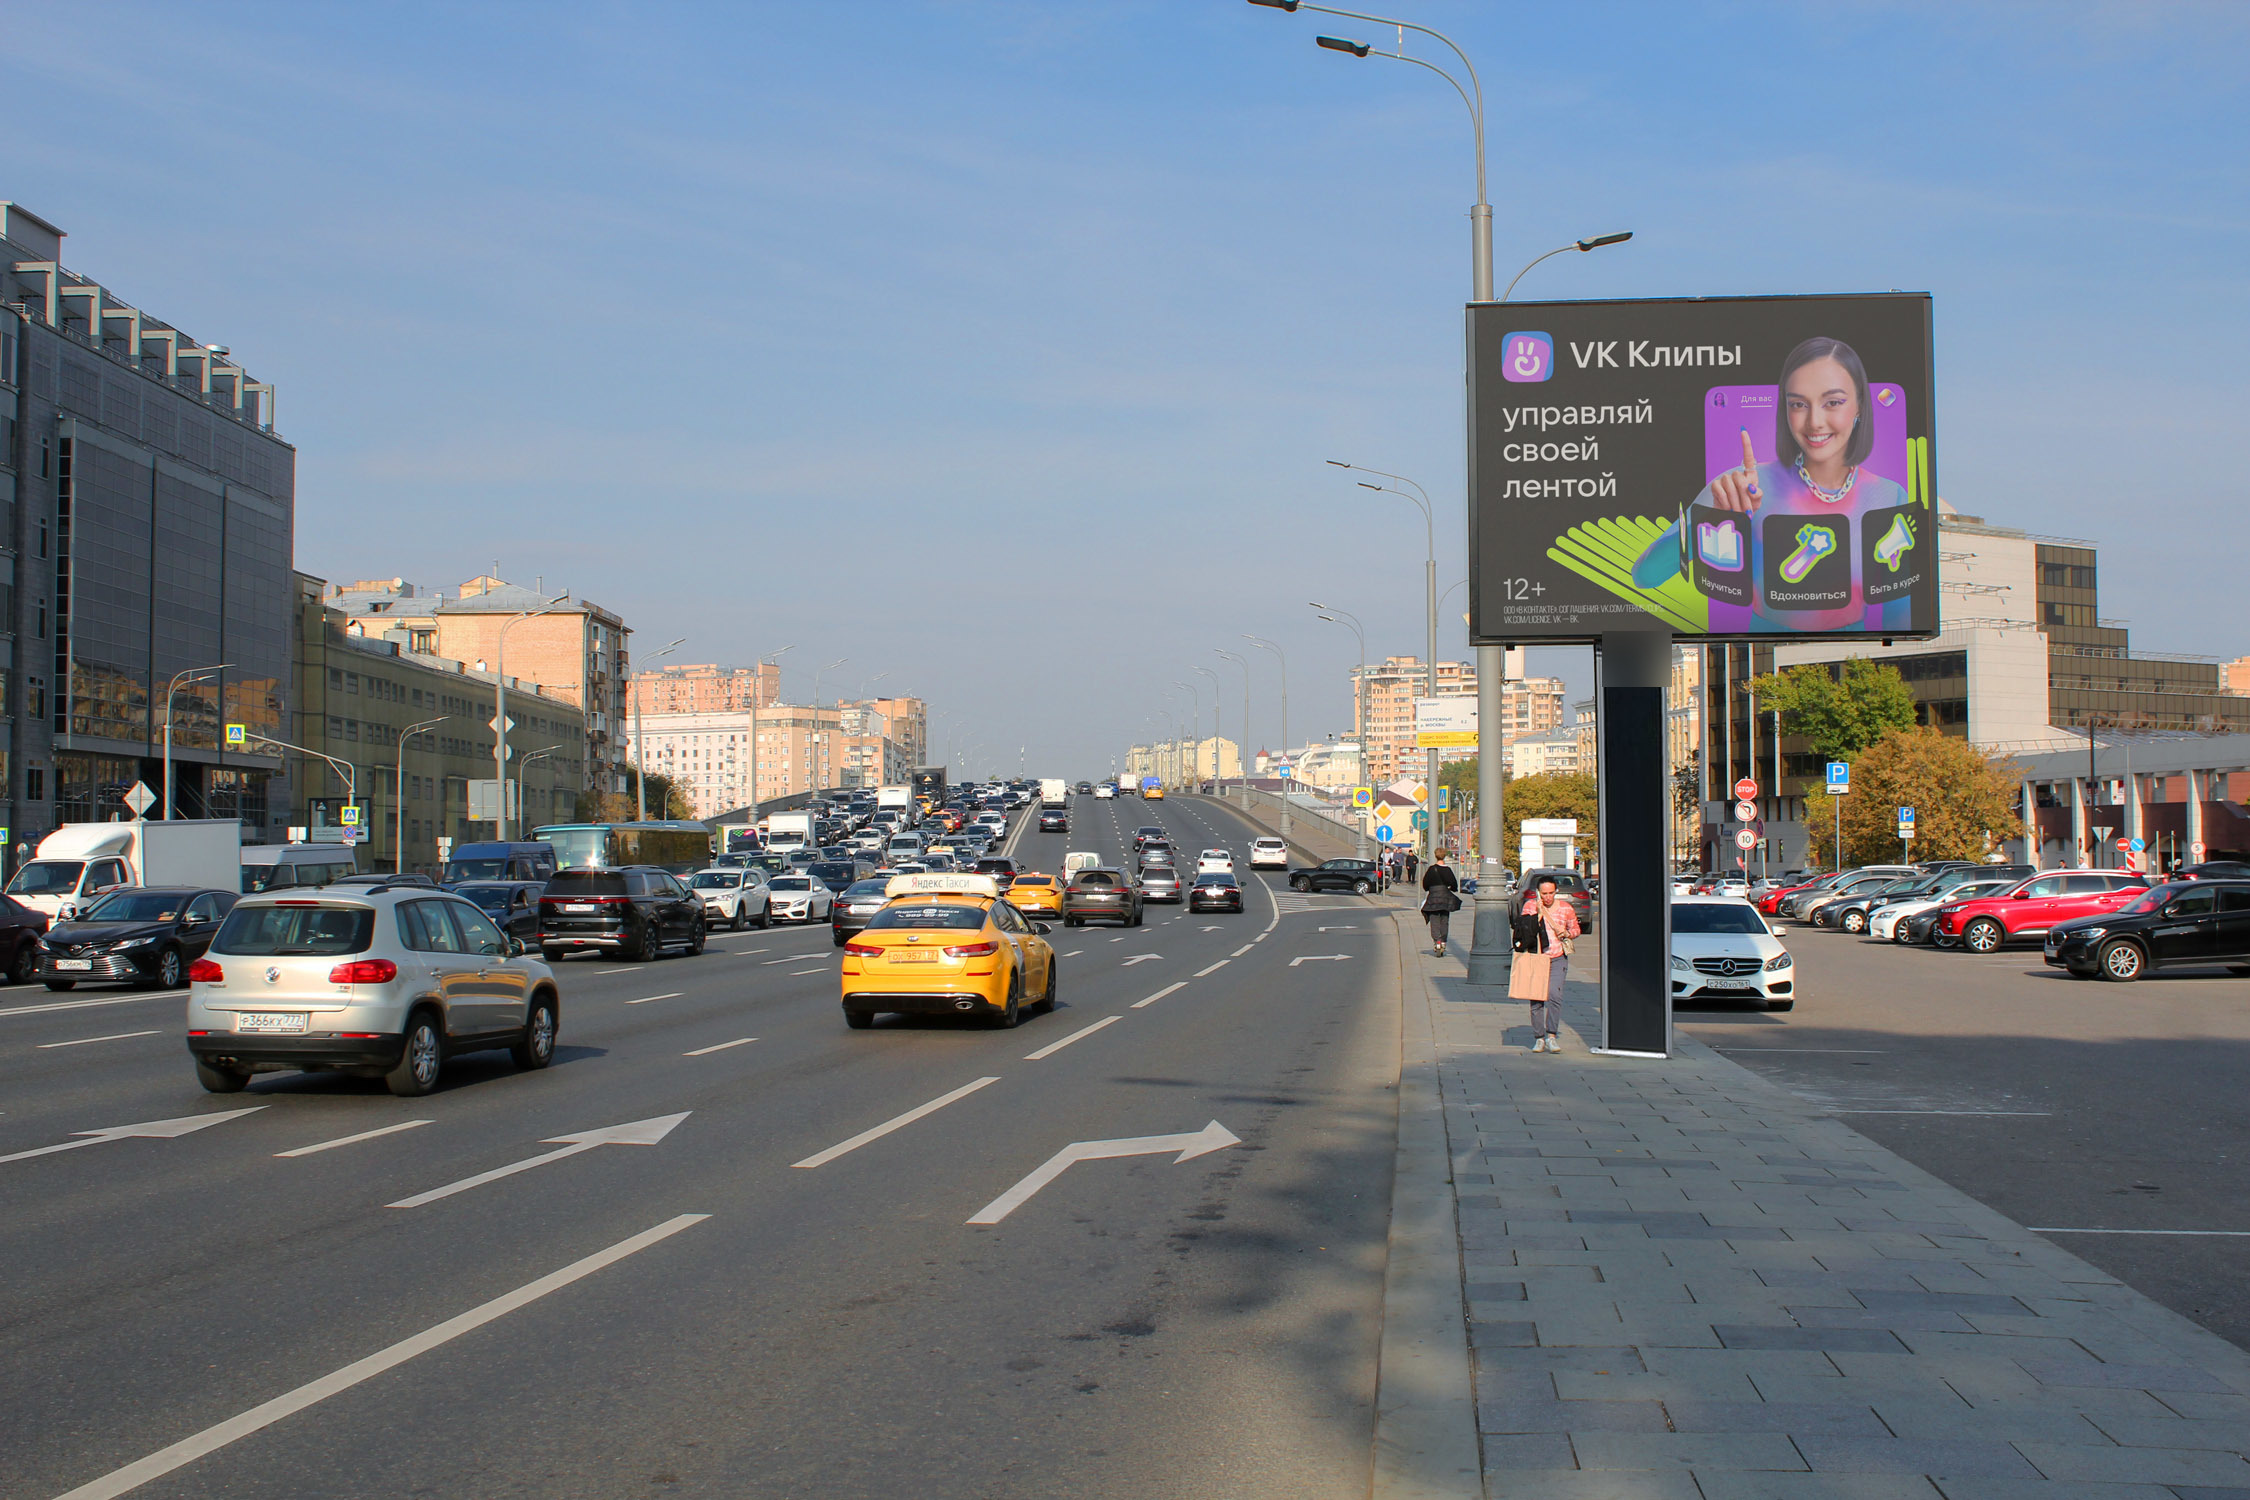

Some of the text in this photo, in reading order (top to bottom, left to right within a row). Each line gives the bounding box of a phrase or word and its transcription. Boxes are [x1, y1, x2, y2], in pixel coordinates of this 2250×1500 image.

[1570, 340, 1741, 368] VK Клипы
[1741, 395, 1756, 403] Для
[1503, 399, 1653, 432] управляй
[1503, 436, 1599, 462] своей
[1503, 472, 1616, 498] лентой
[1503, 578, 1546, 600] 12+
[1701, 575, 1742, 596] Научиться
[1870, 573, 1921, 595] Быть в курсе
[1770, 590, 1846, 601] Вдохновиться
[1833, 765, 1845, 782] P
[1903, 809, 1912, 821] P
[1742, 836, 1751, 844] 10
[912, 876, 970, 888] Яндекс Такси
